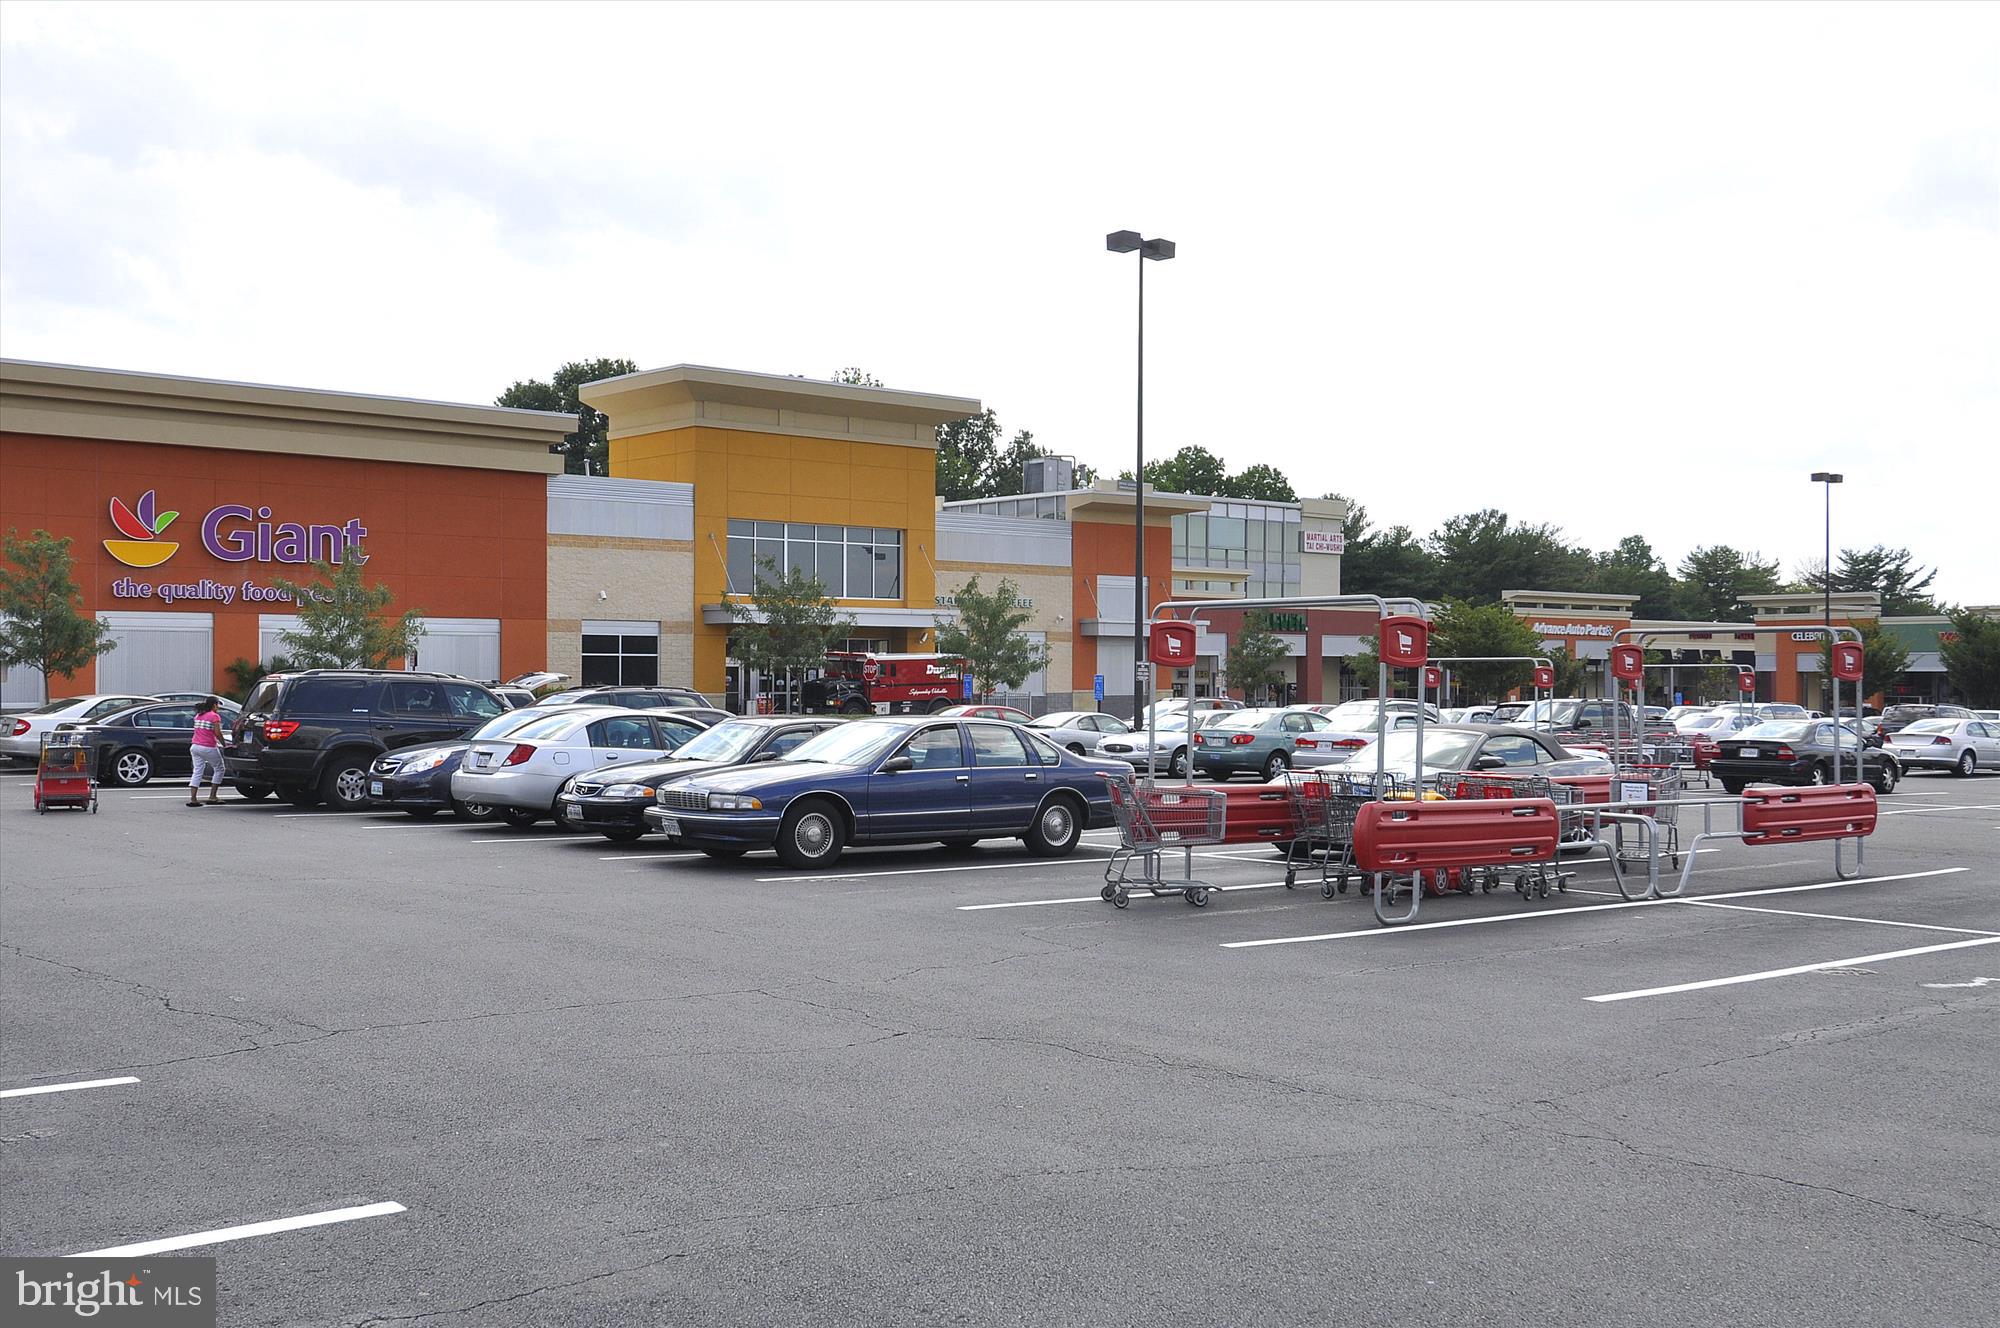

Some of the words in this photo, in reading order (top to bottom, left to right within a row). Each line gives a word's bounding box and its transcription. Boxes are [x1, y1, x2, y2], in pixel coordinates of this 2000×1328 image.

[201, 504, 370, 565] Giant
[1306, 533, 1328, 541] MARTIAL
[1330, 534, 1343, 542] ARTS
[1306, 542, 1315, 550] TAI
[112, 576, 153, 598] the
[157, 579, 236, 604] quality
[242, 581, 292, 602] food
[1566, 624, 1585, 635] Auto
[863, 664, 877, 674] STOP
